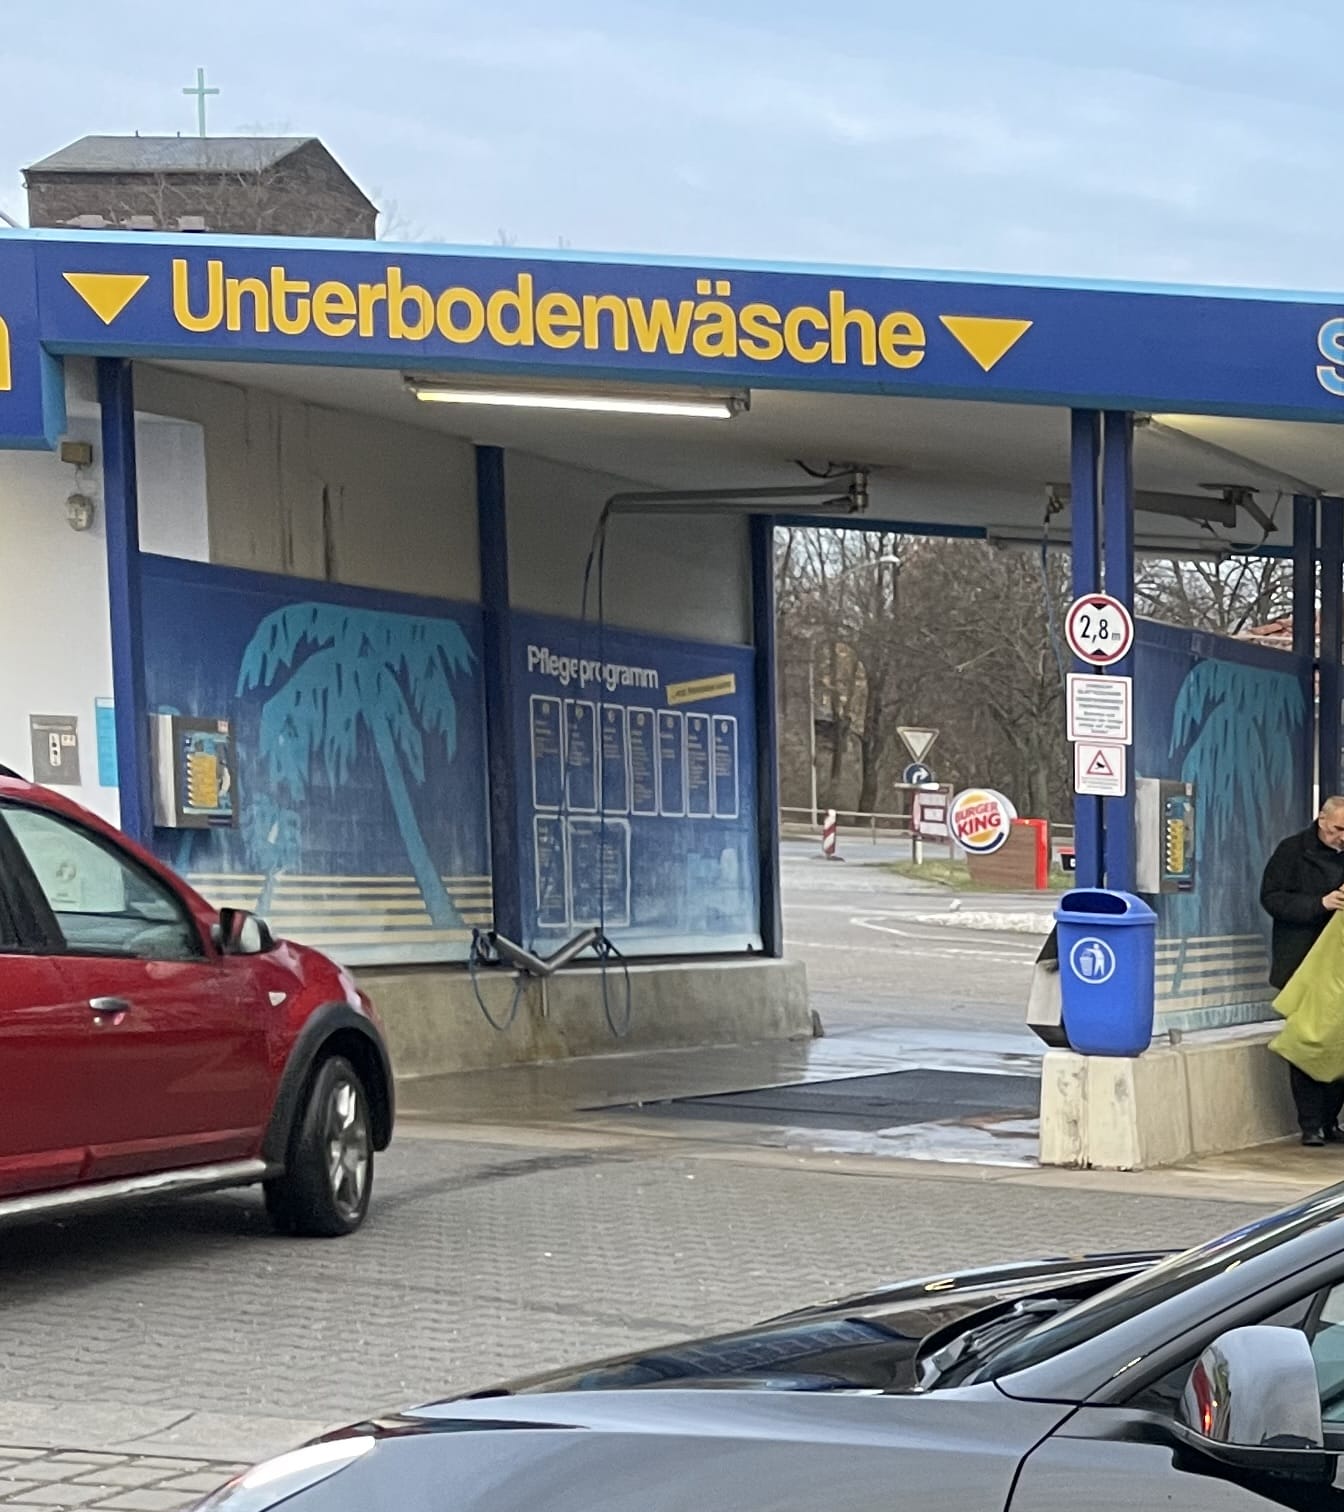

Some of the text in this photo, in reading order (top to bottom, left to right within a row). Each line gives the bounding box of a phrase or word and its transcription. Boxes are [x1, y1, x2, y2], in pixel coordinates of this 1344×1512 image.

[171, 258, 926, 370] Unterbodenwäsche
[1079, 614, 1109, 644] 2,8
[954, 801, 998, 824] BURGER
[957, 812, 1002, 839] KING
